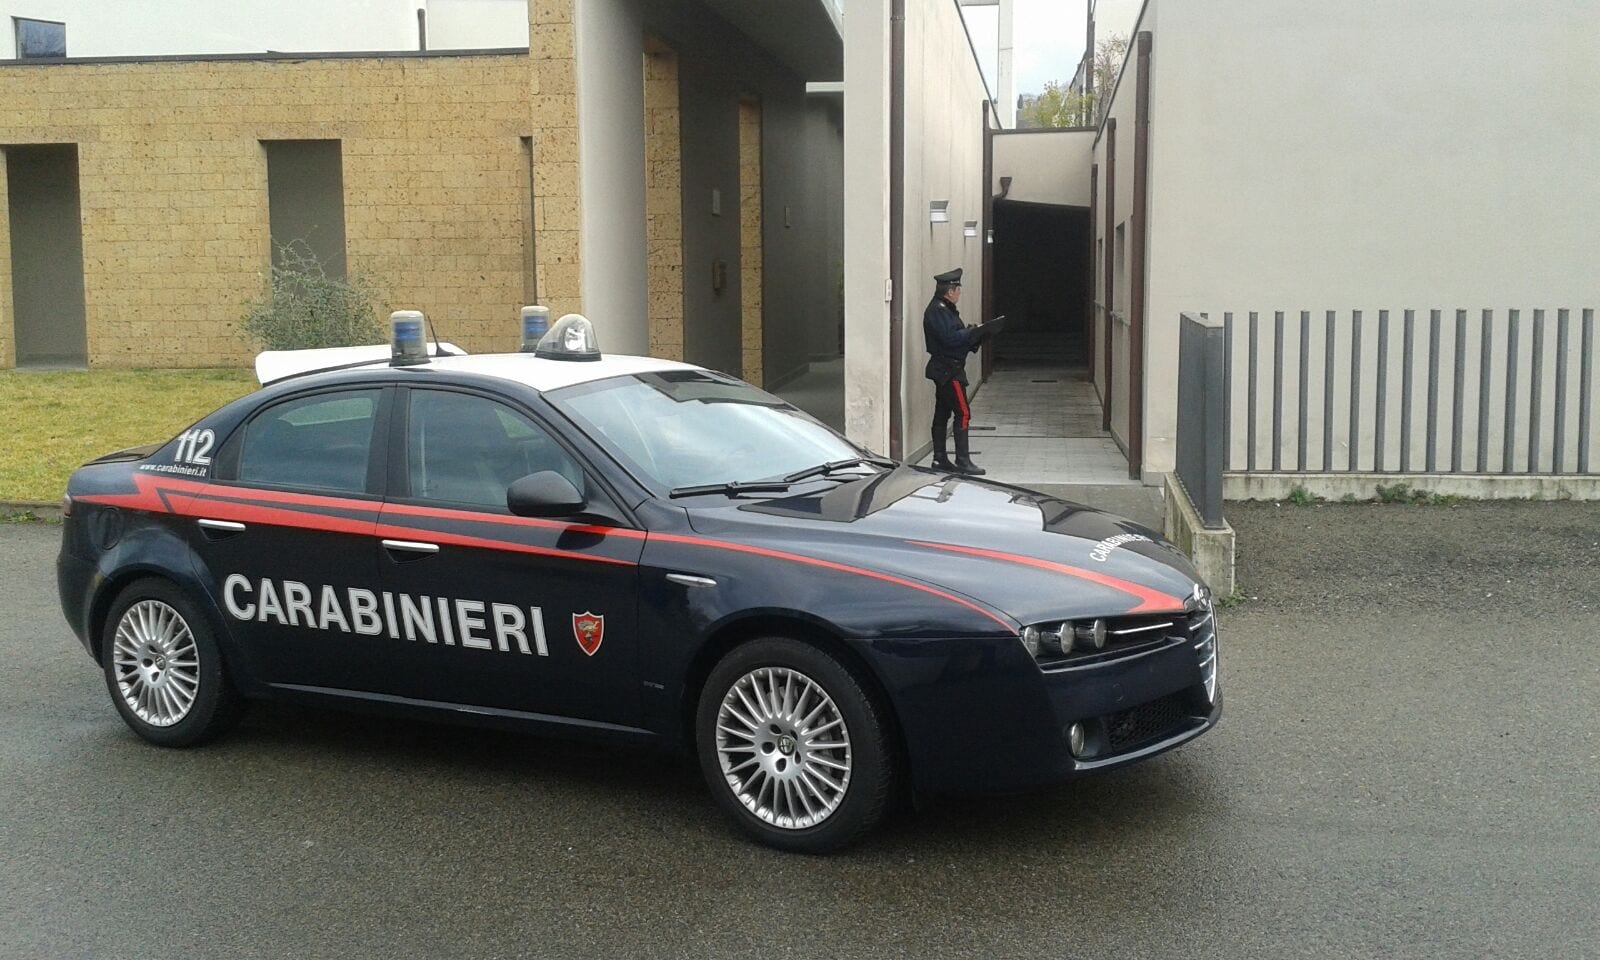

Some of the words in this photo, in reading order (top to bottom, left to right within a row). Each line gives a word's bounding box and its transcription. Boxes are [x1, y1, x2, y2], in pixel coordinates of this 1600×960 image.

[174, 428, 215, 465] 112
[139, 464, 207, 477] www.carabinieri.it
[223, 573, 549, 657] CARABINIERI
